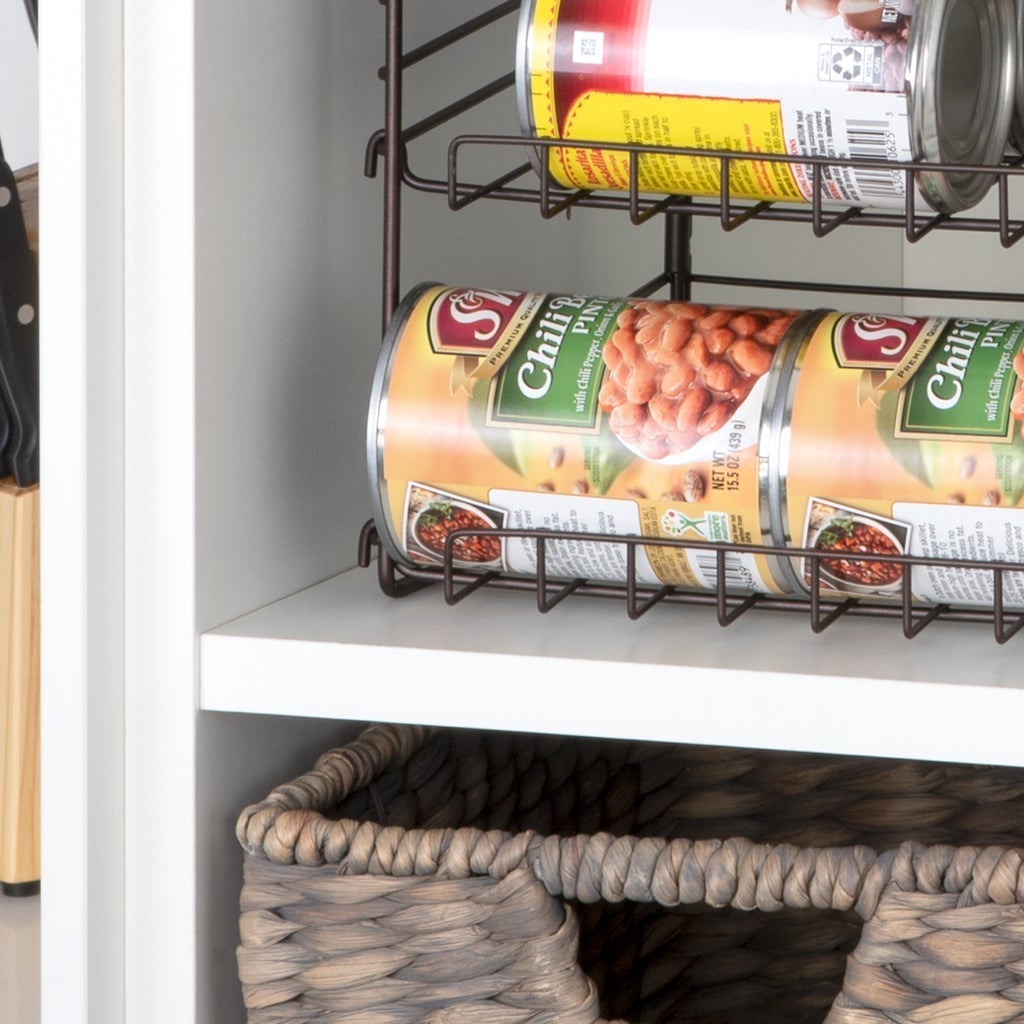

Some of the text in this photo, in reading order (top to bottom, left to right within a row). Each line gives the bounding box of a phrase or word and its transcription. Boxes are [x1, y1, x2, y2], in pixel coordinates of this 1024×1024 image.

[881, 9, 898, 23] NET
[489, 323, 522, 366] PREMIUM
[517, 311, 573, 400] Chili
[897, 338, 931, 378] PREMIUM
[577, 366, 591, 390] Chili
[927, 329, 981, 409] Chili
[988, 376, 1003, 400] Chili
[573, 390, 586, 413] with
[982, 400, 998, 422] with
[712, 451, 726, 490] NET WT
[727, 419, 746, 491] 15.5 OZ (439 g)
